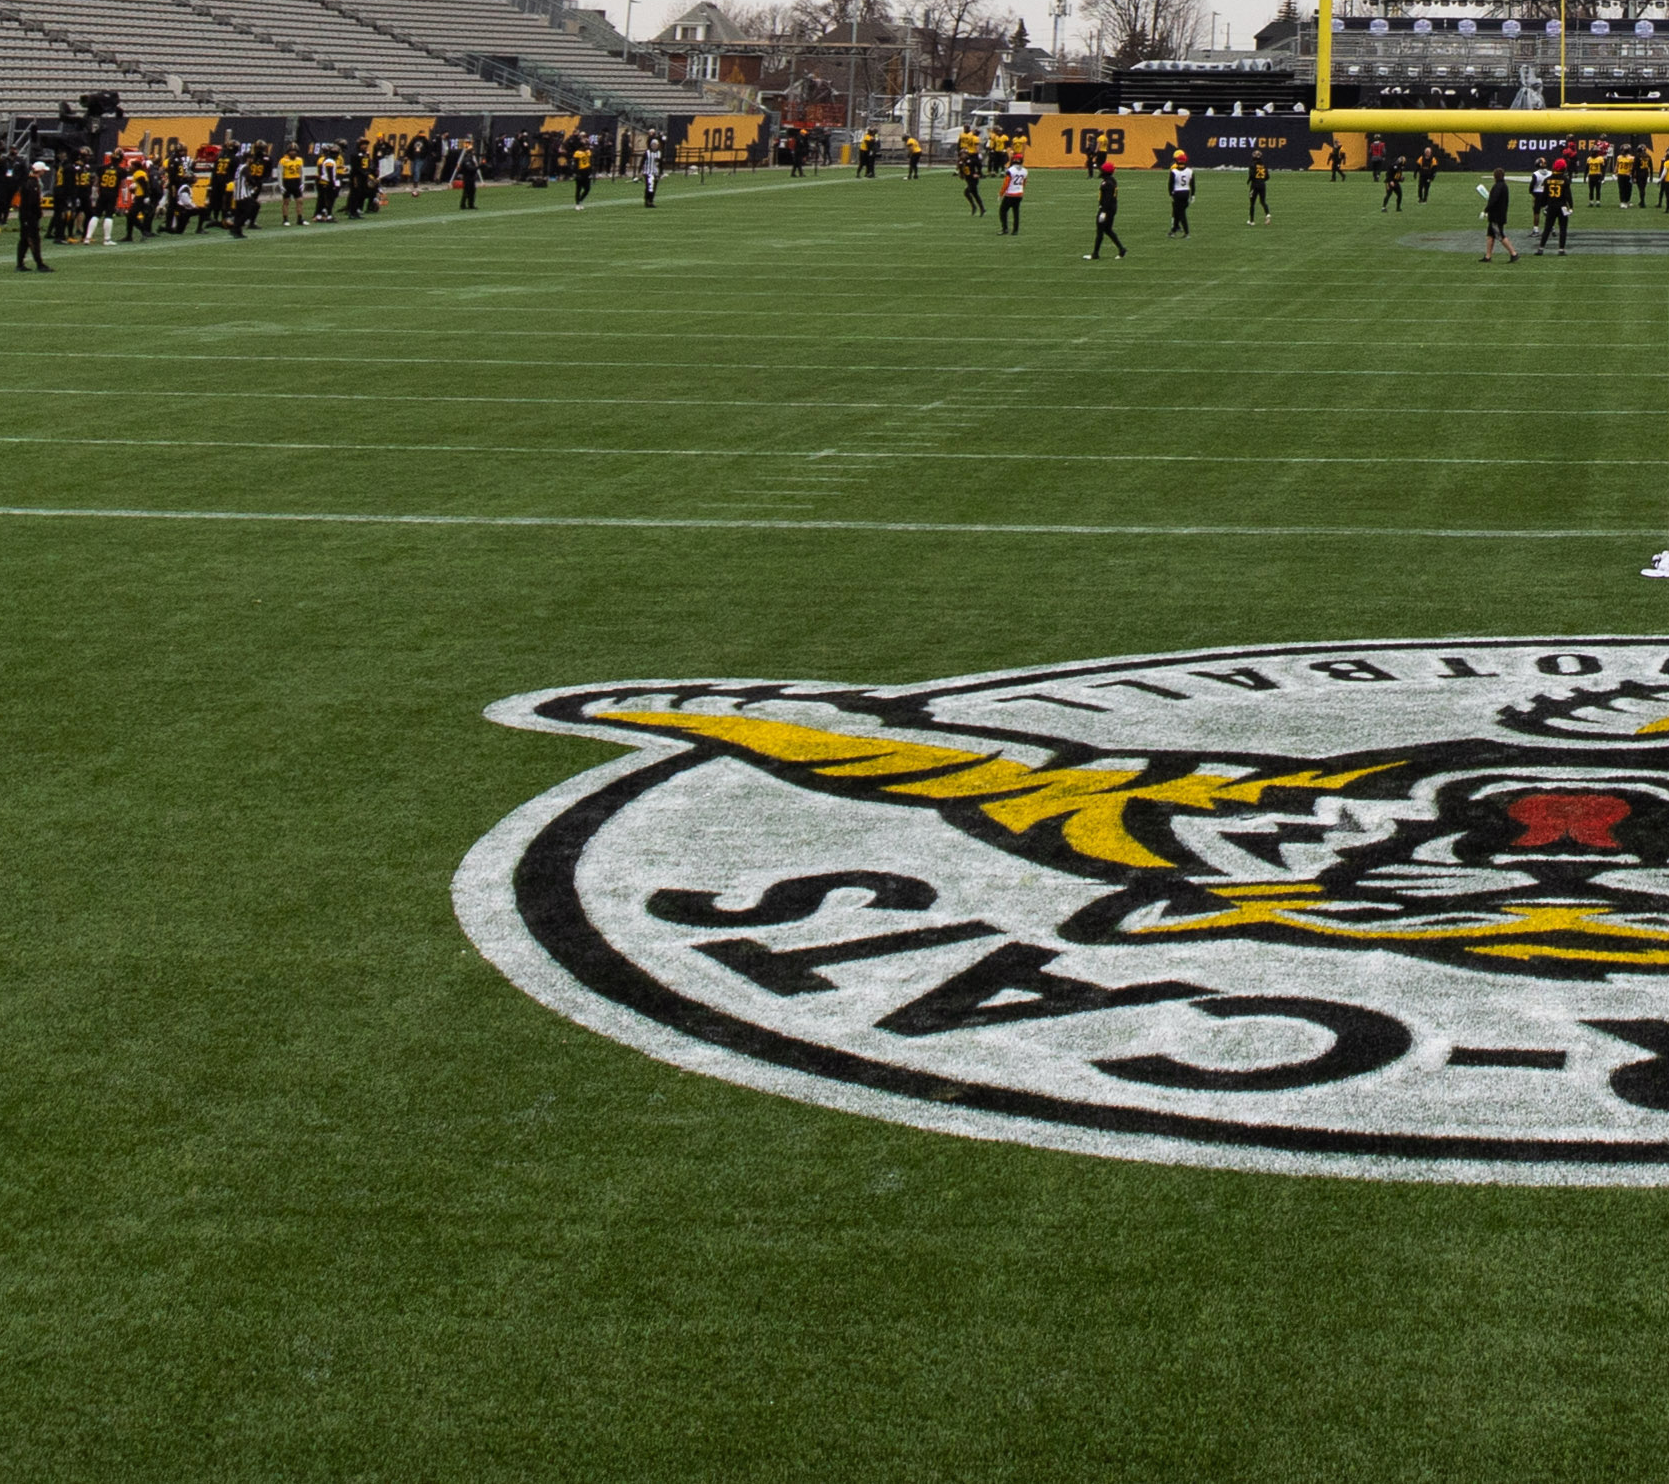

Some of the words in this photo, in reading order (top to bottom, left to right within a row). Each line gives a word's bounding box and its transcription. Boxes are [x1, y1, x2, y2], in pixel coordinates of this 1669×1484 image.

[702, 127, 735, 152] 108
[1207, 137, 1287, 149] #GREYCUP
[1549, 184, 1562, 198] 53
